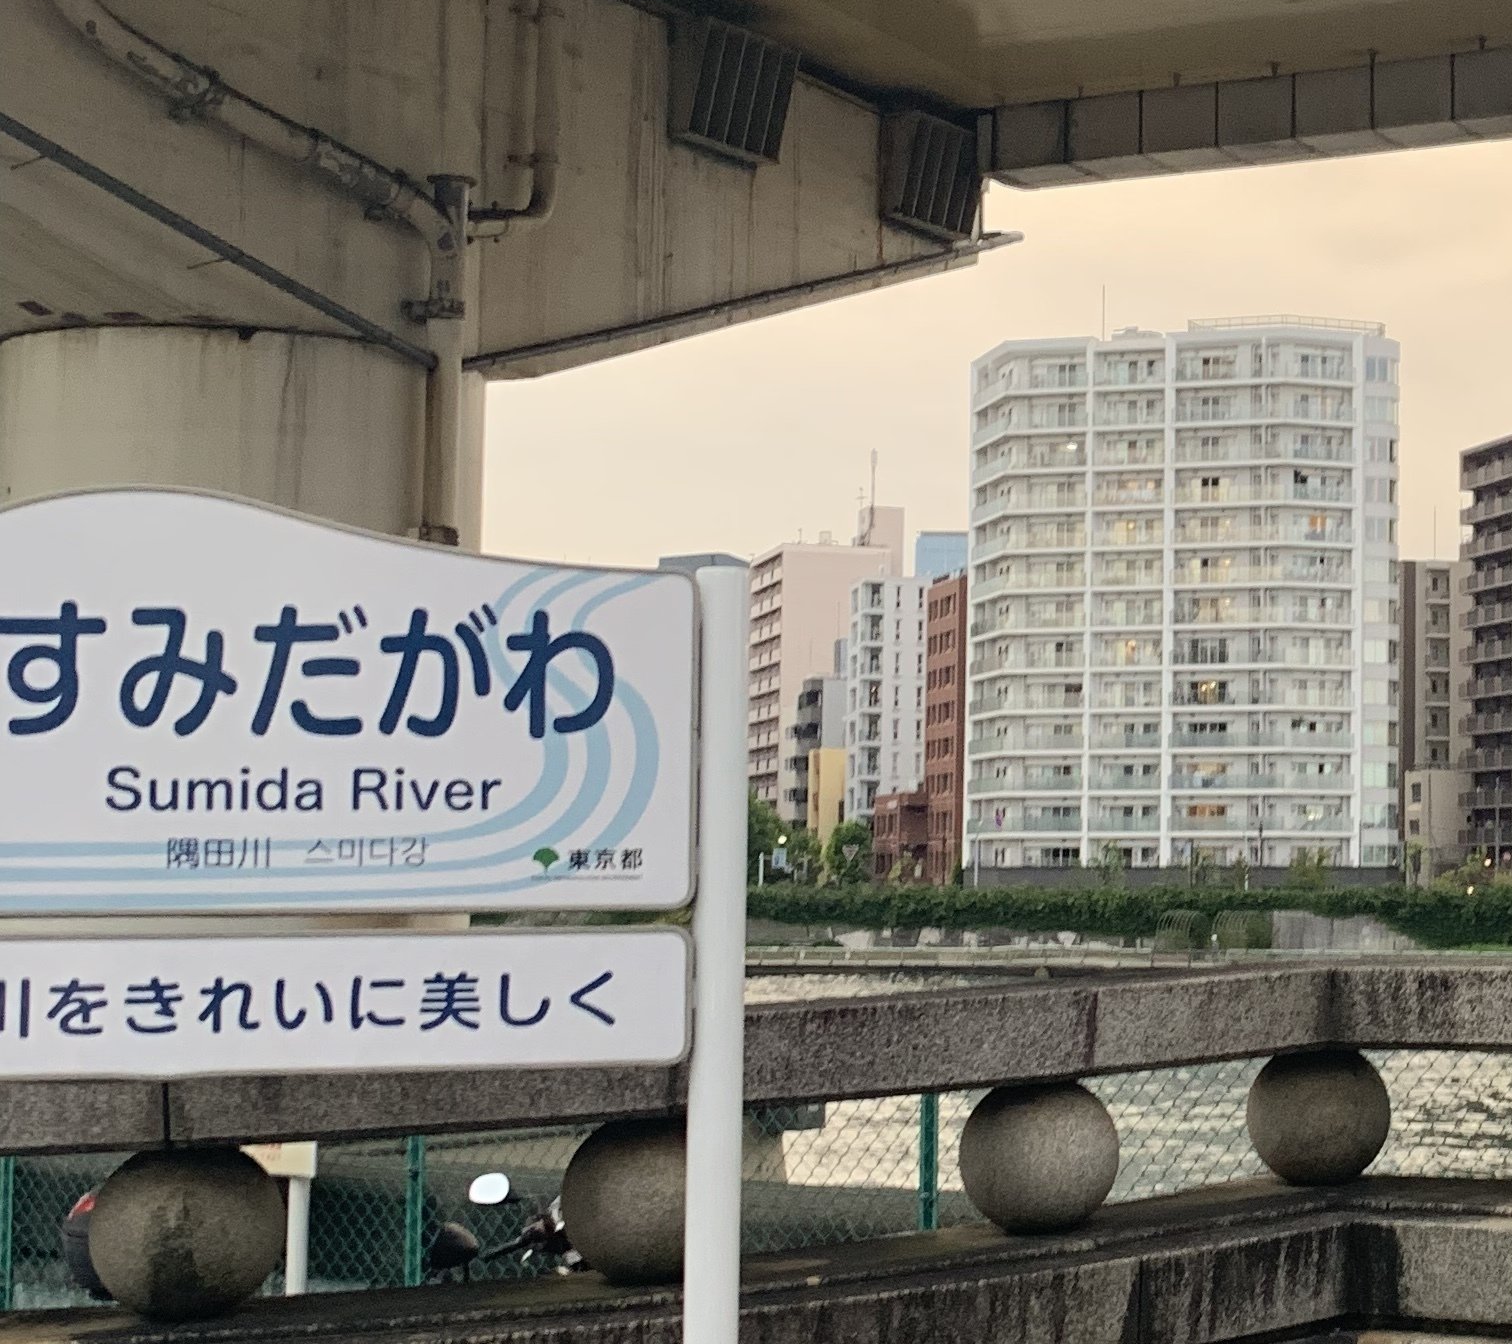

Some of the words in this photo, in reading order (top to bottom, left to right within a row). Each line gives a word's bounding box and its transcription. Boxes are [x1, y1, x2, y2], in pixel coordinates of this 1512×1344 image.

[0, 601, 616, 738] すみだがわ
[105, 765, 324, 812] Sumida
[352, 766, 502, 811] River
[166, 837, 272, 870] 隅田川
[305, 837, 430, 868] 스미다강
[567, 847, 644, 870] 東京都
